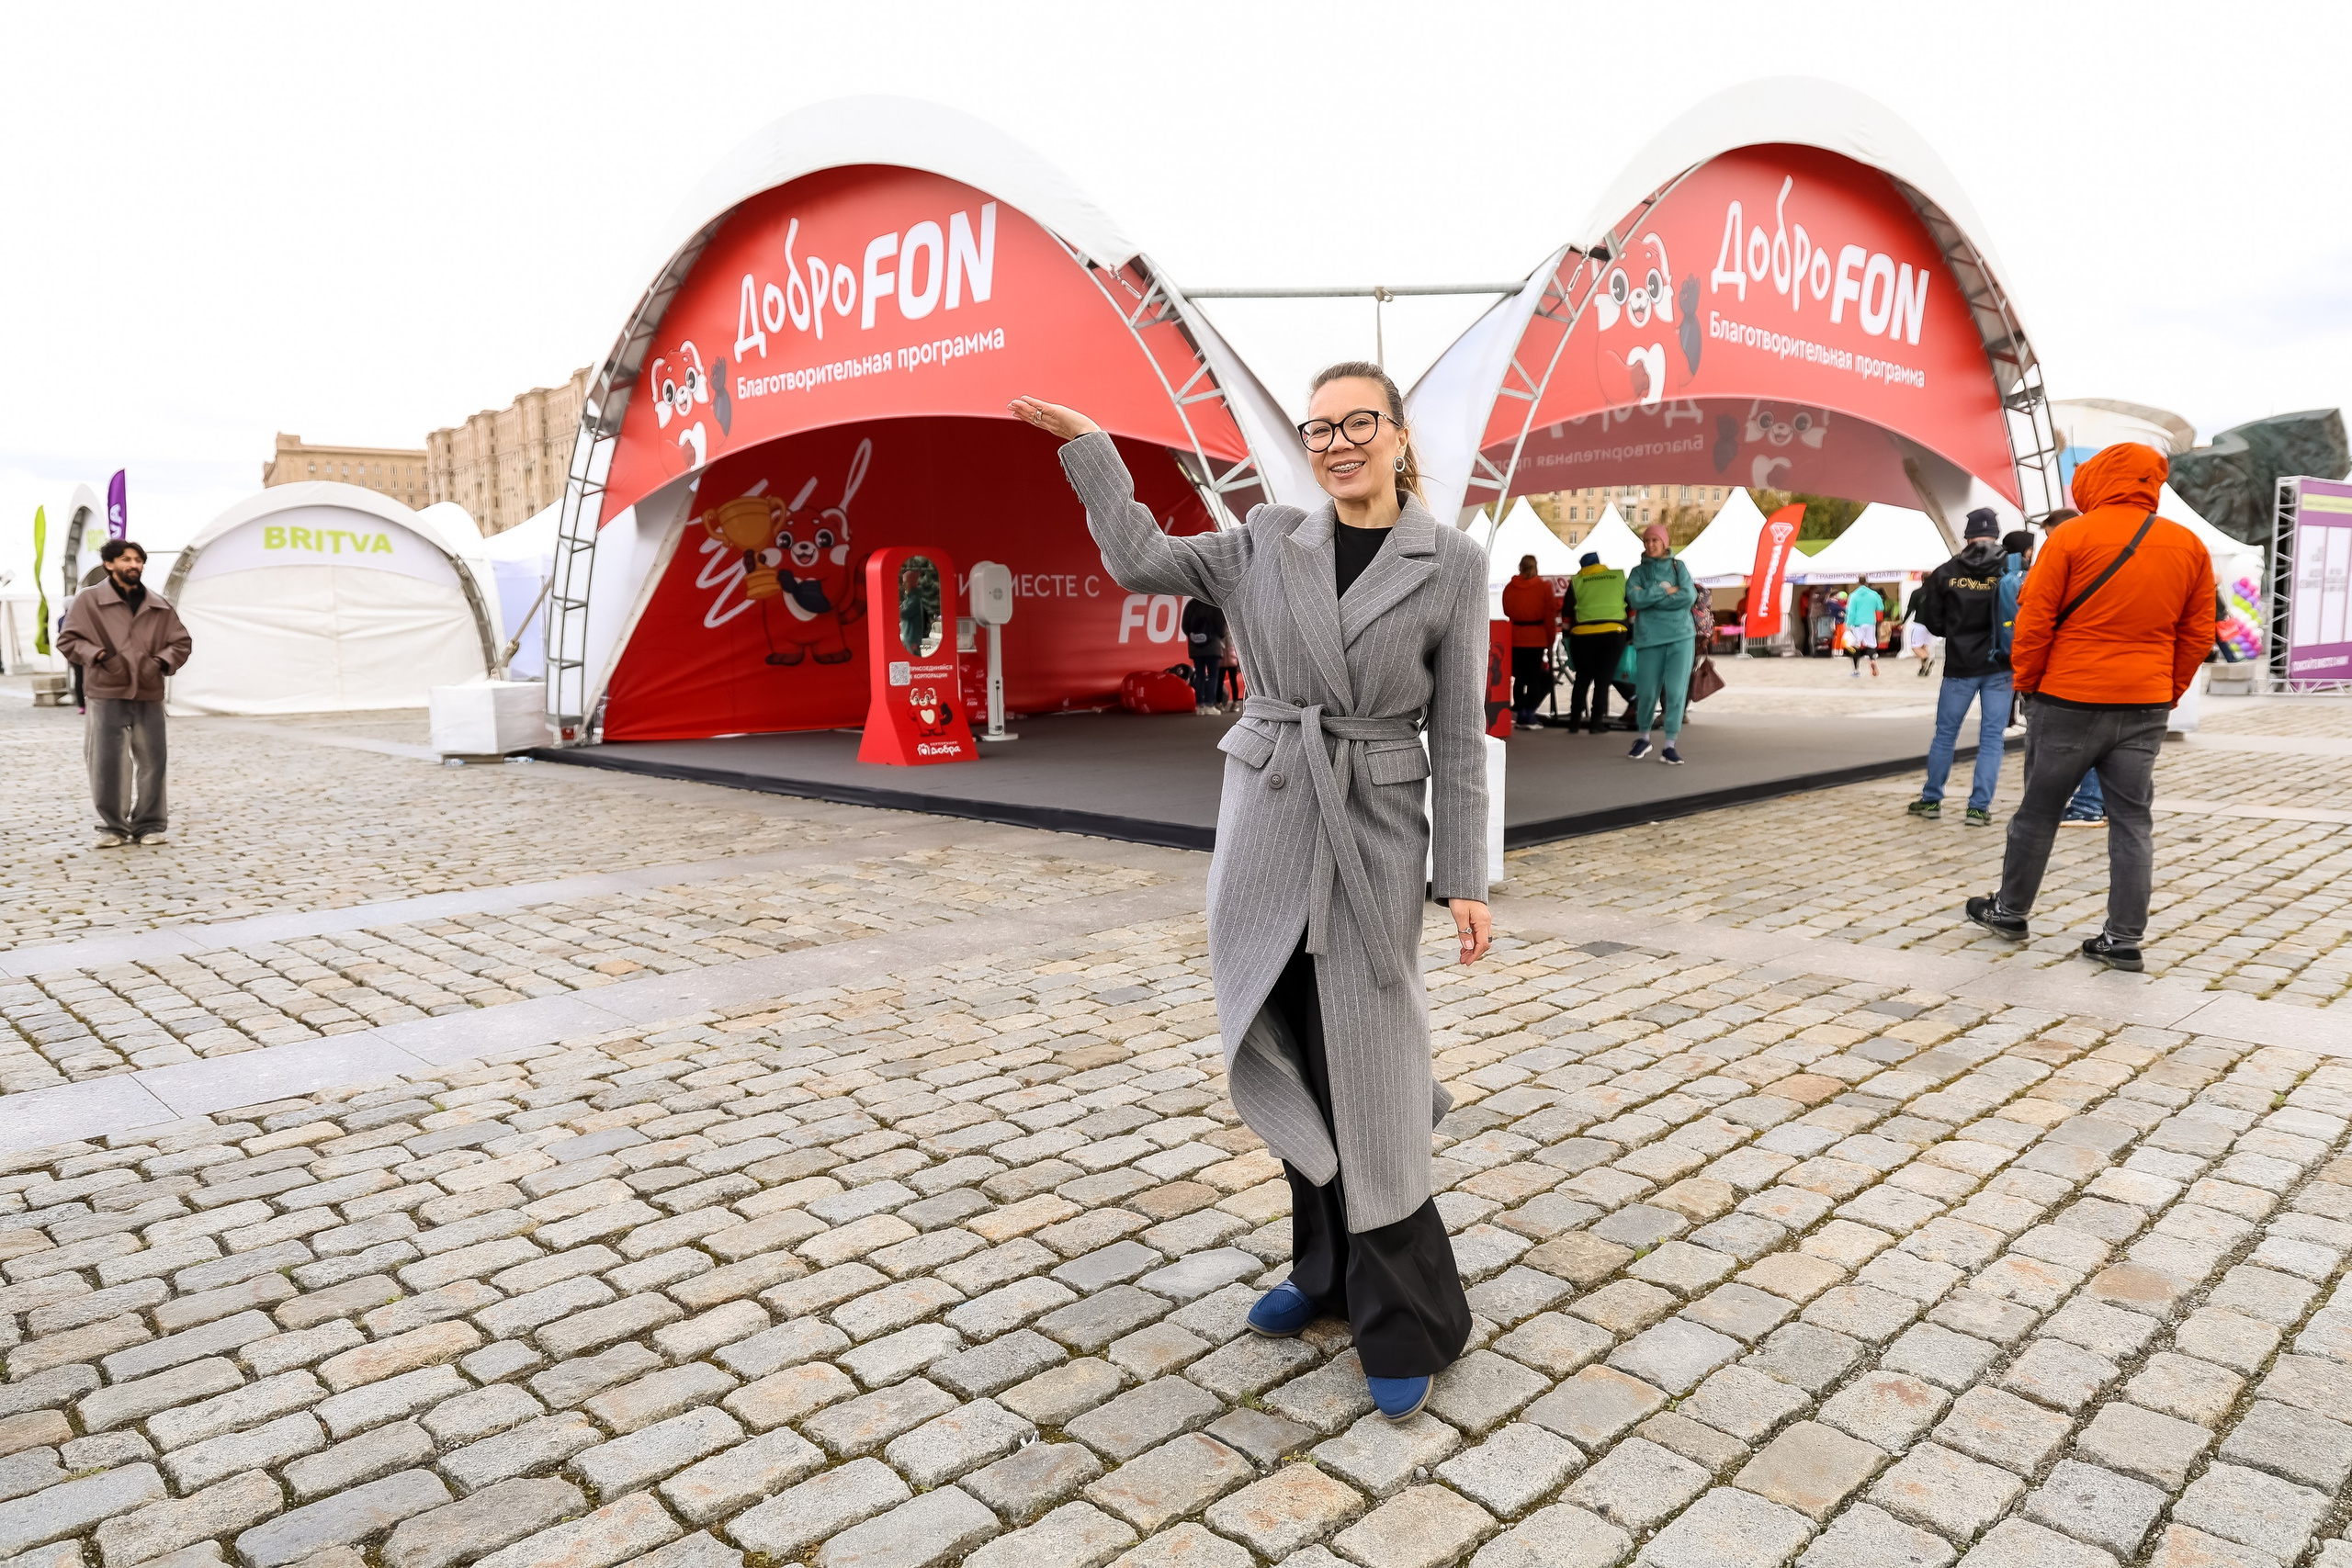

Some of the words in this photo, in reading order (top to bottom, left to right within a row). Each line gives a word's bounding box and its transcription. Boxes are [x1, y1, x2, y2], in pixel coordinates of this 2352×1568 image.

[737, 351, 893, 400] Благотворительная
[898, 327, 1005, 373] программа
[1709, 310, 1854, 370] Благотворительная
[1855, 354, 1926, 389] программа
[264, 525, 393, 554] BRITVA
[1012, 573, 1078, 597] ЕСТЕ
[1084, 574, 1100, 597] С
[1758, 545, 1782, 617] ГРАВИРОВКА
